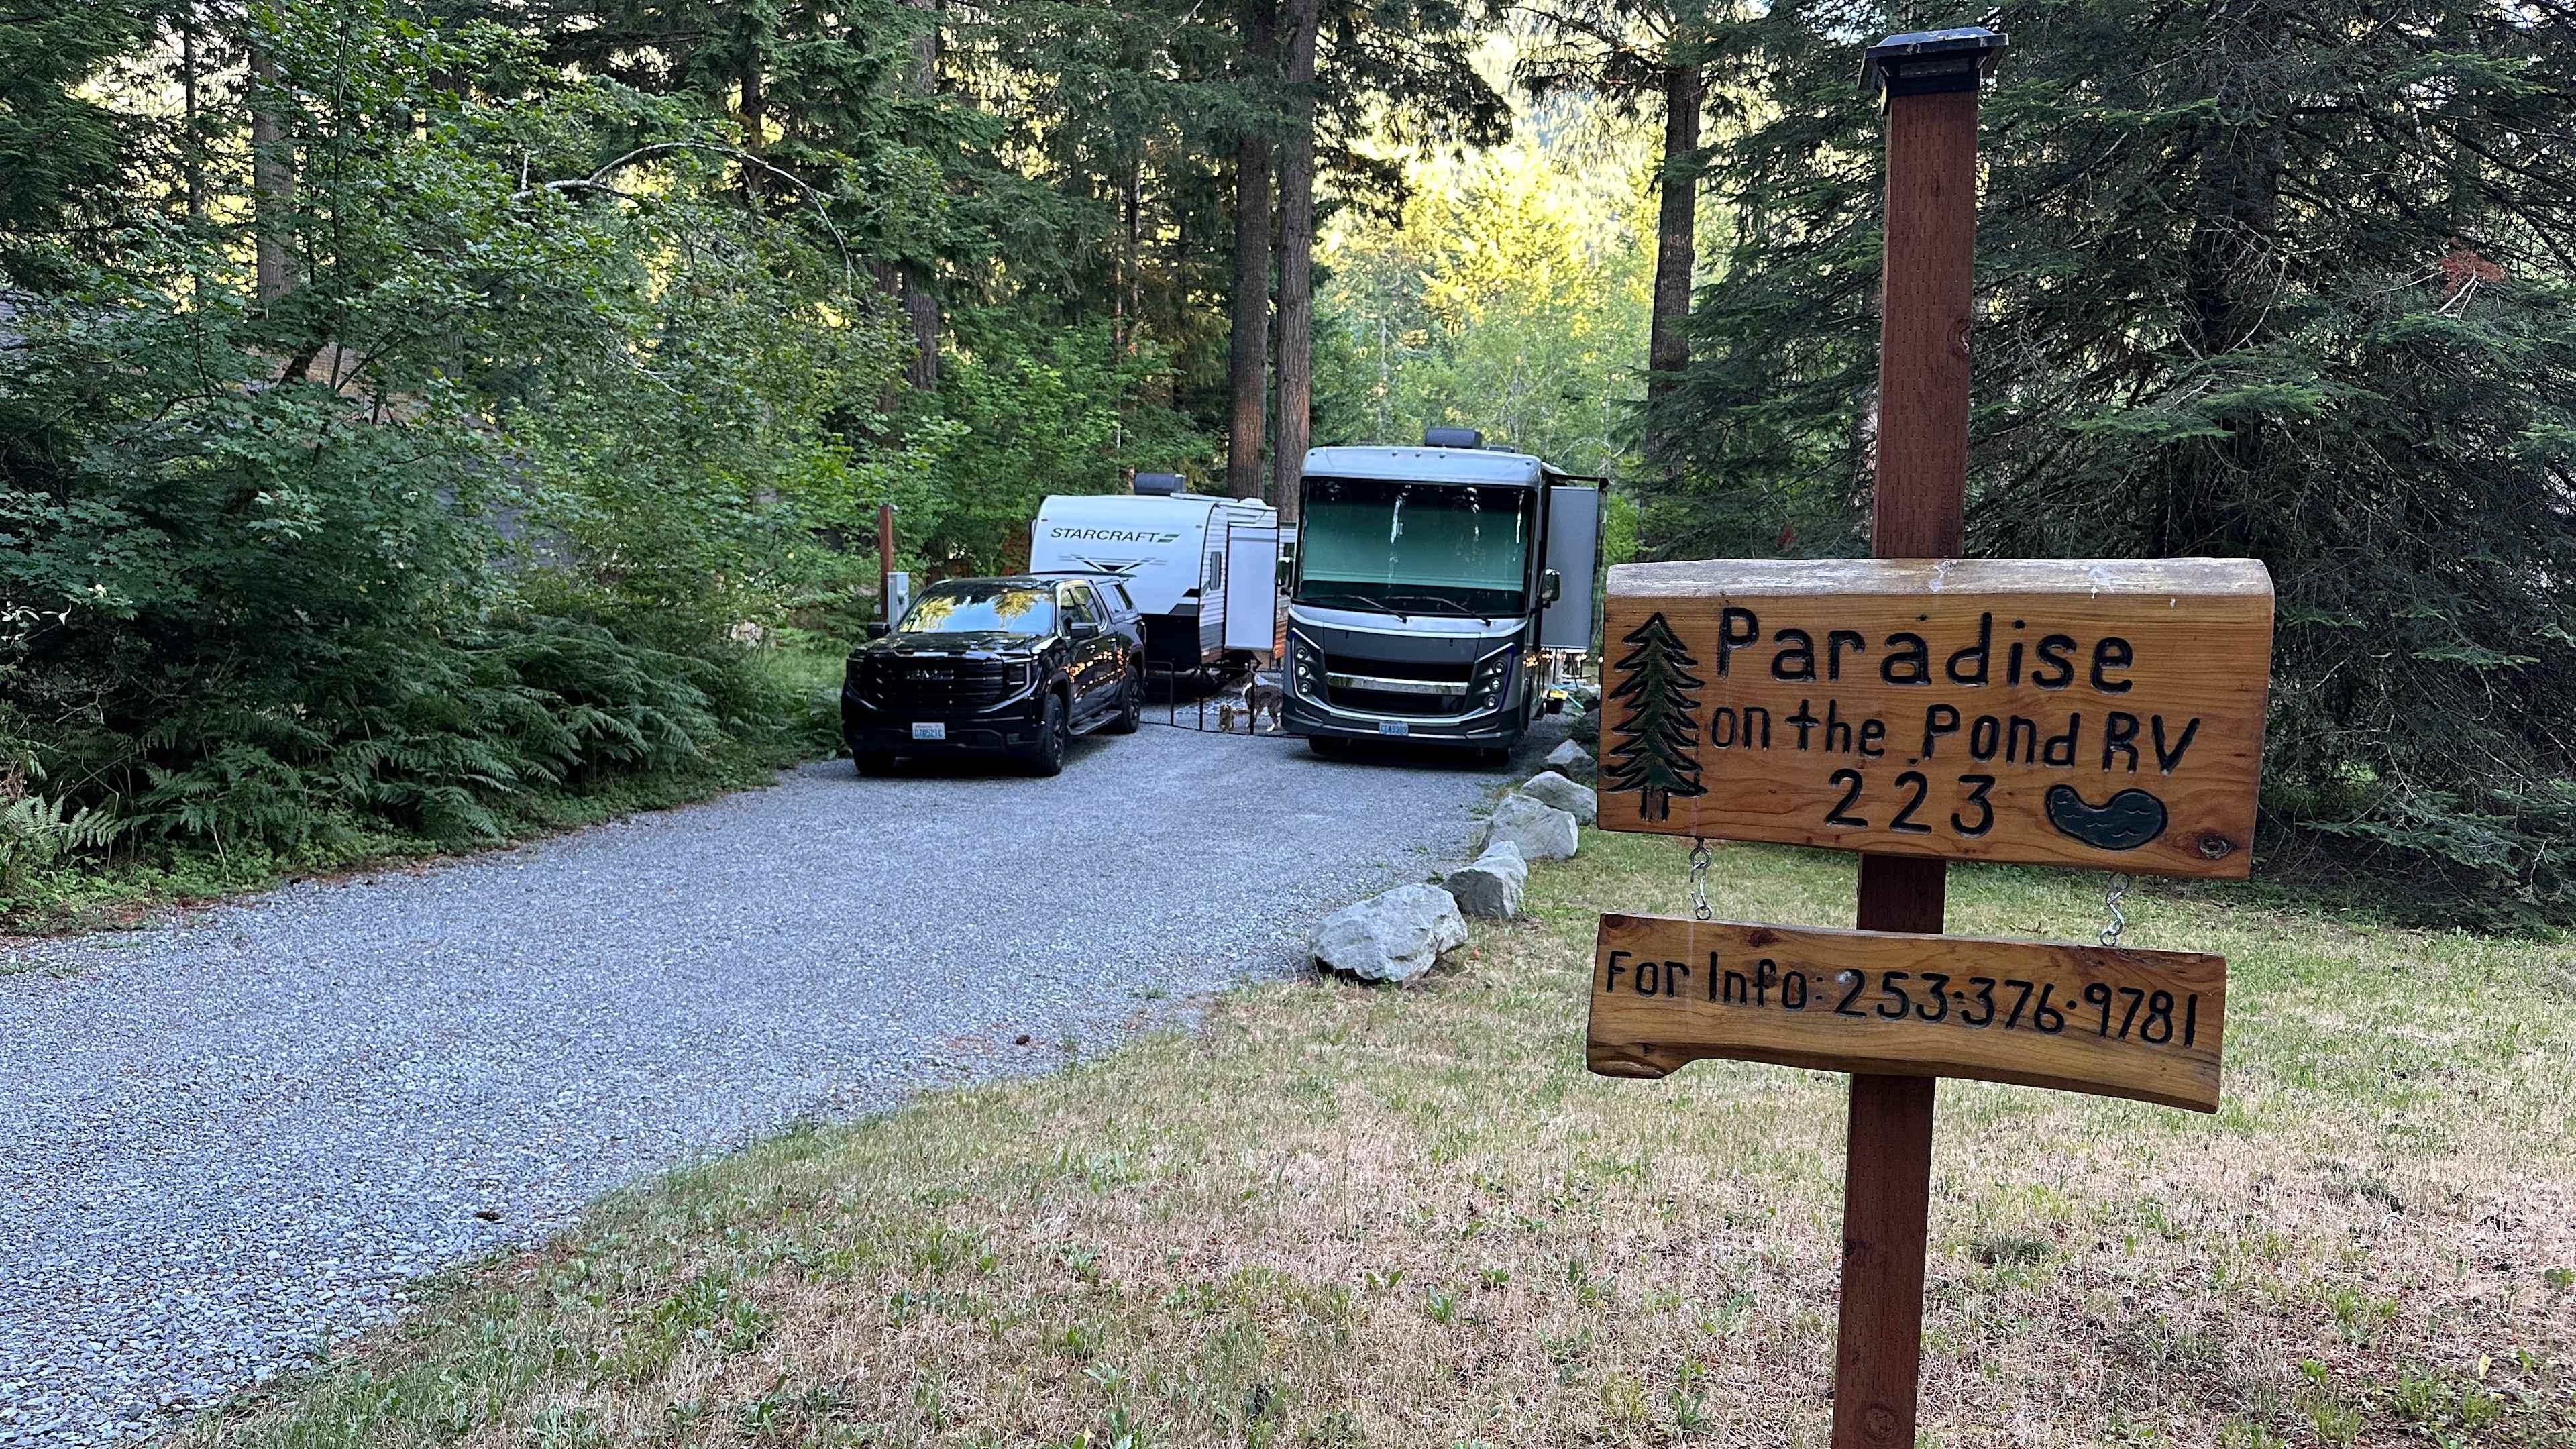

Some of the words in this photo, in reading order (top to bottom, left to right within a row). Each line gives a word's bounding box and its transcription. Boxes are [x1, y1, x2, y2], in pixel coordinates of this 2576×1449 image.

[1051, 527, 1160, 543] STARCRAFT
[1717, 606, 2134, 694] Paradise
[1711, 706, 1771, 751] on
[1785, 698, 1886, 759] the
[1921, 703, 2081, 769] Pond
[2101, 710, 2200, 776] RV
[1824, 769, 1996, 839] 223
[1607, 950, 1690, 998] For
[1709, 951, 1823, 1011] Info:
